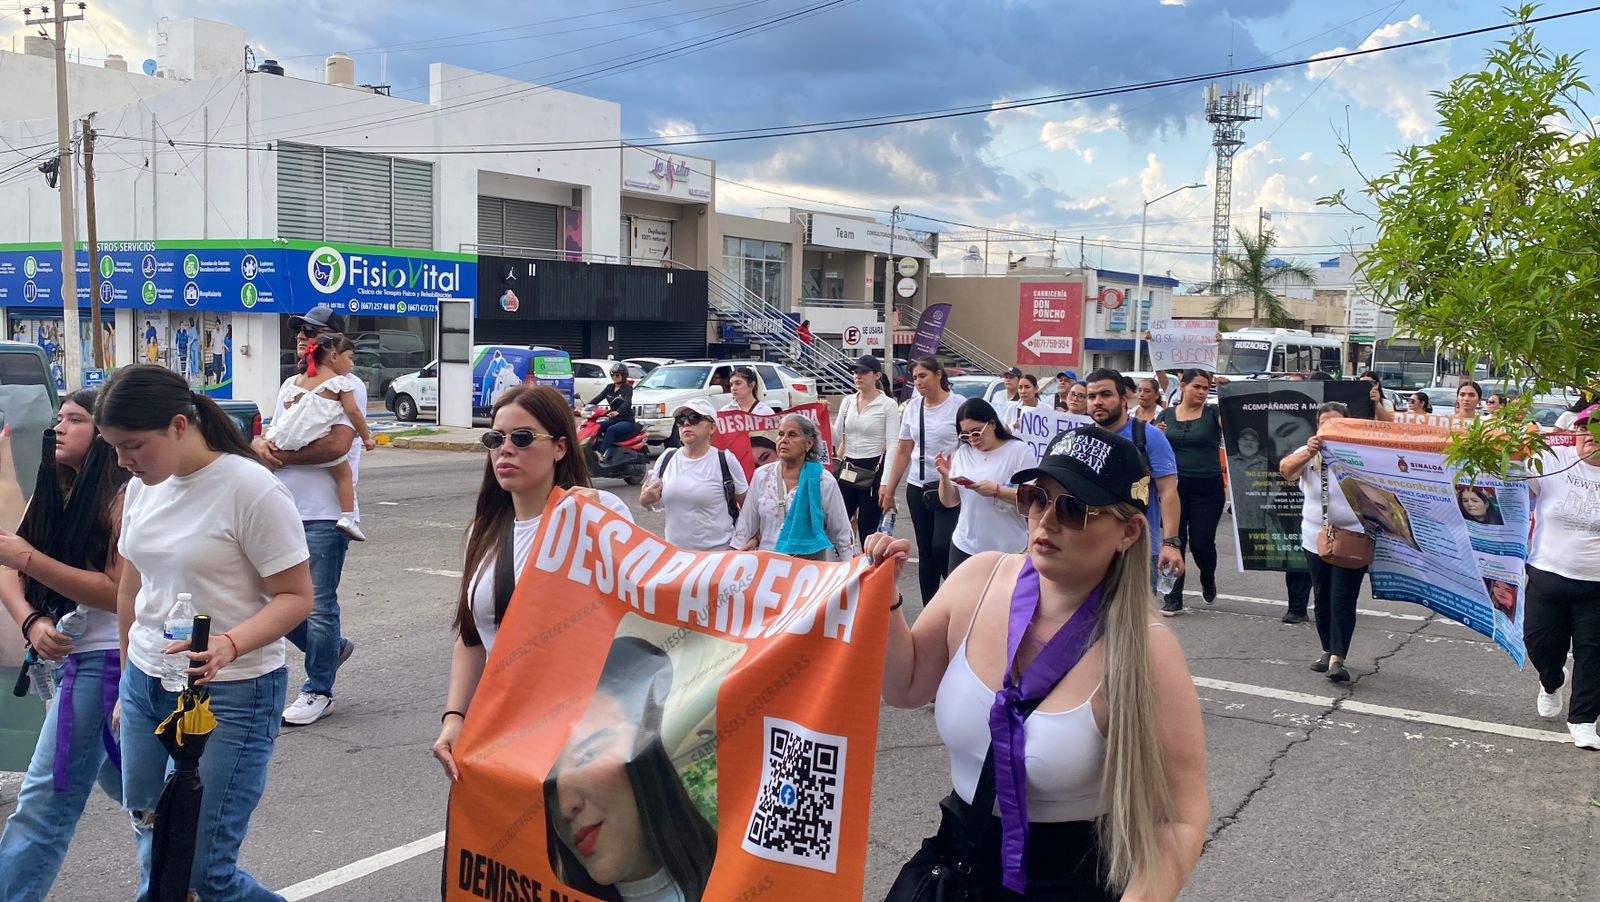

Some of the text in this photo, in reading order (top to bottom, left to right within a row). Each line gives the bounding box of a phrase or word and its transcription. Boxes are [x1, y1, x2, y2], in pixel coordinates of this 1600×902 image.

[835, 227, 855, 240] Team
[83, 241, 156, 252] NSTROS SERVICIOS
[349, 255, 460, 292] FisioVital
[383, 289, 402, 297] Terapia
[360, 302, 373, 311] (667)
[374, 302, 382, 310] 257
[407, 303, 419, 312] (667)
[420, 304, 429, 312] 472
[1033, 299, 1050, 309] DON
[1033, 309, 1066, 319] PONCHO
[862, 326, 868, 335] SE
[1234, 341, 1270, 351] HUIZACHES
[1154, 348, 1217, 362] SE BUSCAN
[1242, 401, 1299, 412] ACOMPÁÑANOS
[1020, 412, 1049, 438] NOS
[1075, 434, 1112, 454] FAITH
[1072, 443, 1110, 466] OVER
[1068, 450, 1104, 476] FEAR
[1409, 462, 1443, 471] SINALOA
[1387, 478, 1438, 492] encontrar
[1566, 474, 1591, 490] NEW
[1283, 533, 1298, 541] LOS
[535, 495, 869, 644] DESAPARECIDA
[745, 653, 811, 718] GUERRERAS
[458, 848, 542, 902] DENISSE
